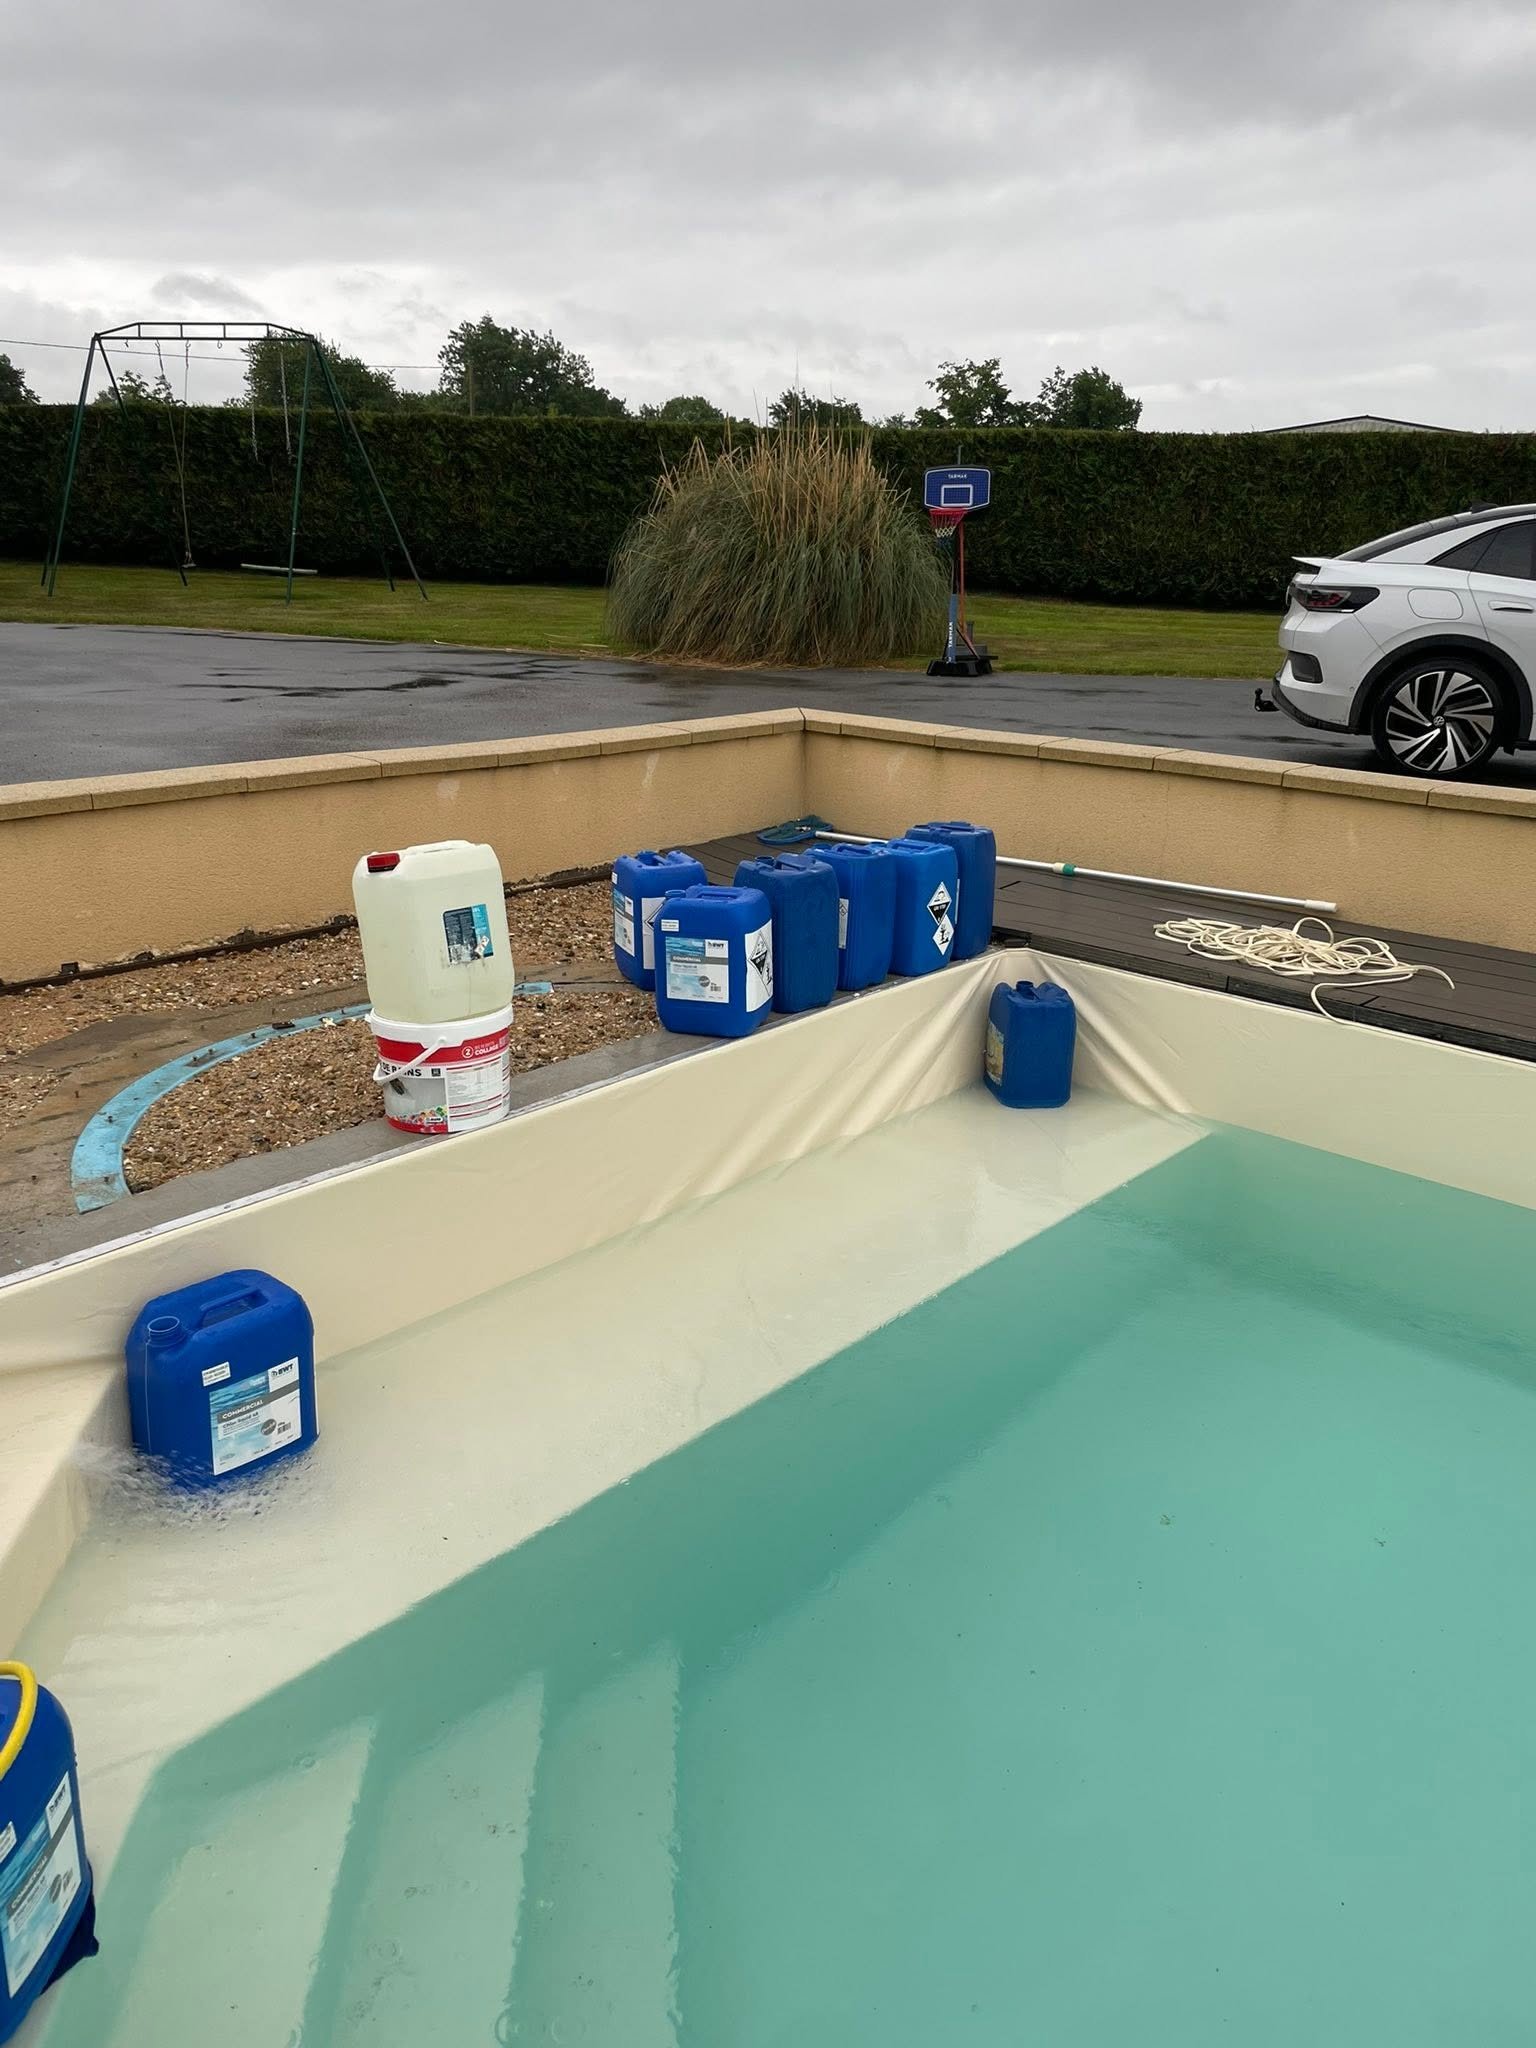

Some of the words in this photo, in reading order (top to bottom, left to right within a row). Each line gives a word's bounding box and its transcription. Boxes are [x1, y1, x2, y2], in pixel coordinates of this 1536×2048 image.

[474, 1044, 499, 1056] COLLAGE
[278, 1363, 294, 1375] BWT
[222, 1399, 264, 1419] COMMERCIAL
